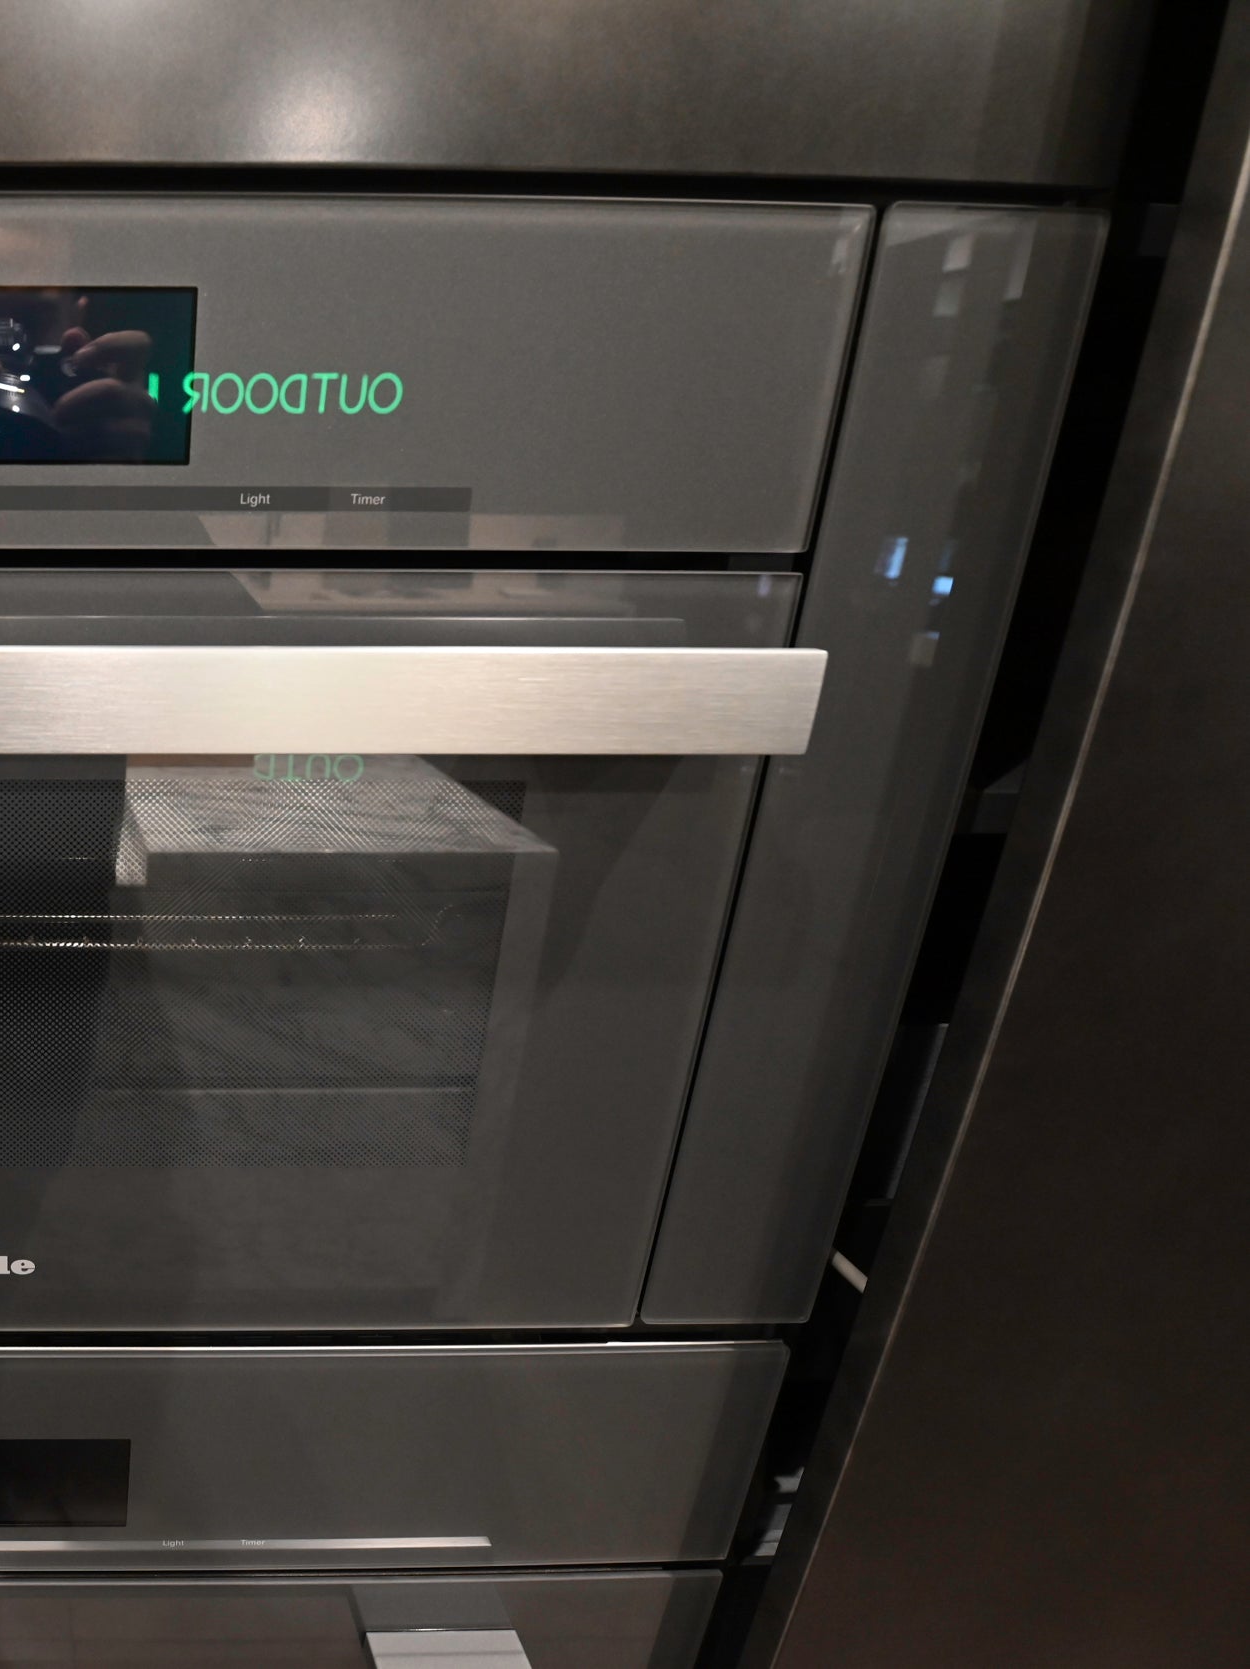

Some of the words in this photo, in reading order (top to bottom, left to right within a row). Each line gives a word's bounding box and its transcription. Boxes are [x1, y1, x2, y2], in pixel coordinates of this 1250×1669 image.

[239, 493, 271, 508] Light
[350, 493, 386, 506] Timer
[162, 1539, 185, 1549] Light
[240, 1538, 267, 1547] Timer
